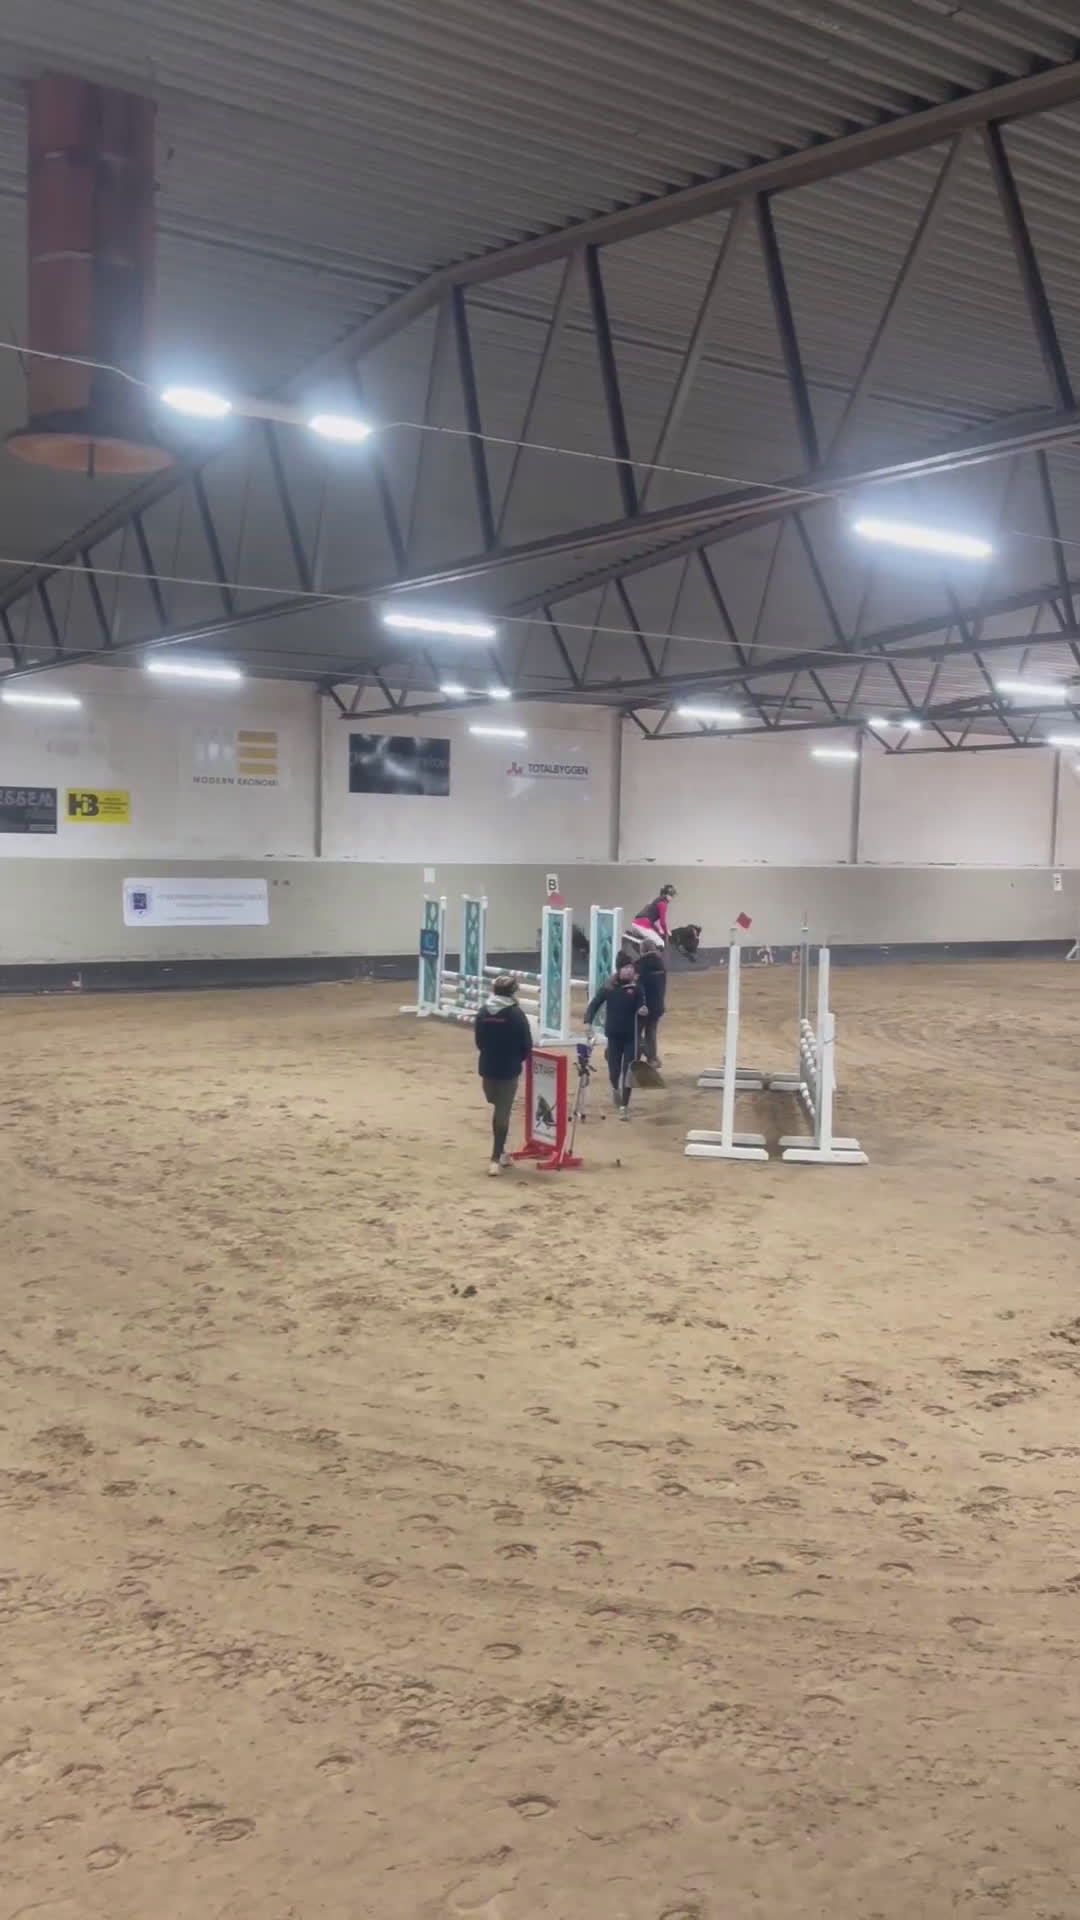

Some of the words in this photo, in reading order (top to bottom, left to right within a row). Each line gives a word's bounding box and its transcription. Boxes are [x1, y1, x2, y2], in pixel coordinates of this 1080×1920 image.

[528, 763, 589, 775] TOTALBYGGEN
[192, 776, 234, 785] MODERN
[548, 878, 557, 891] B
